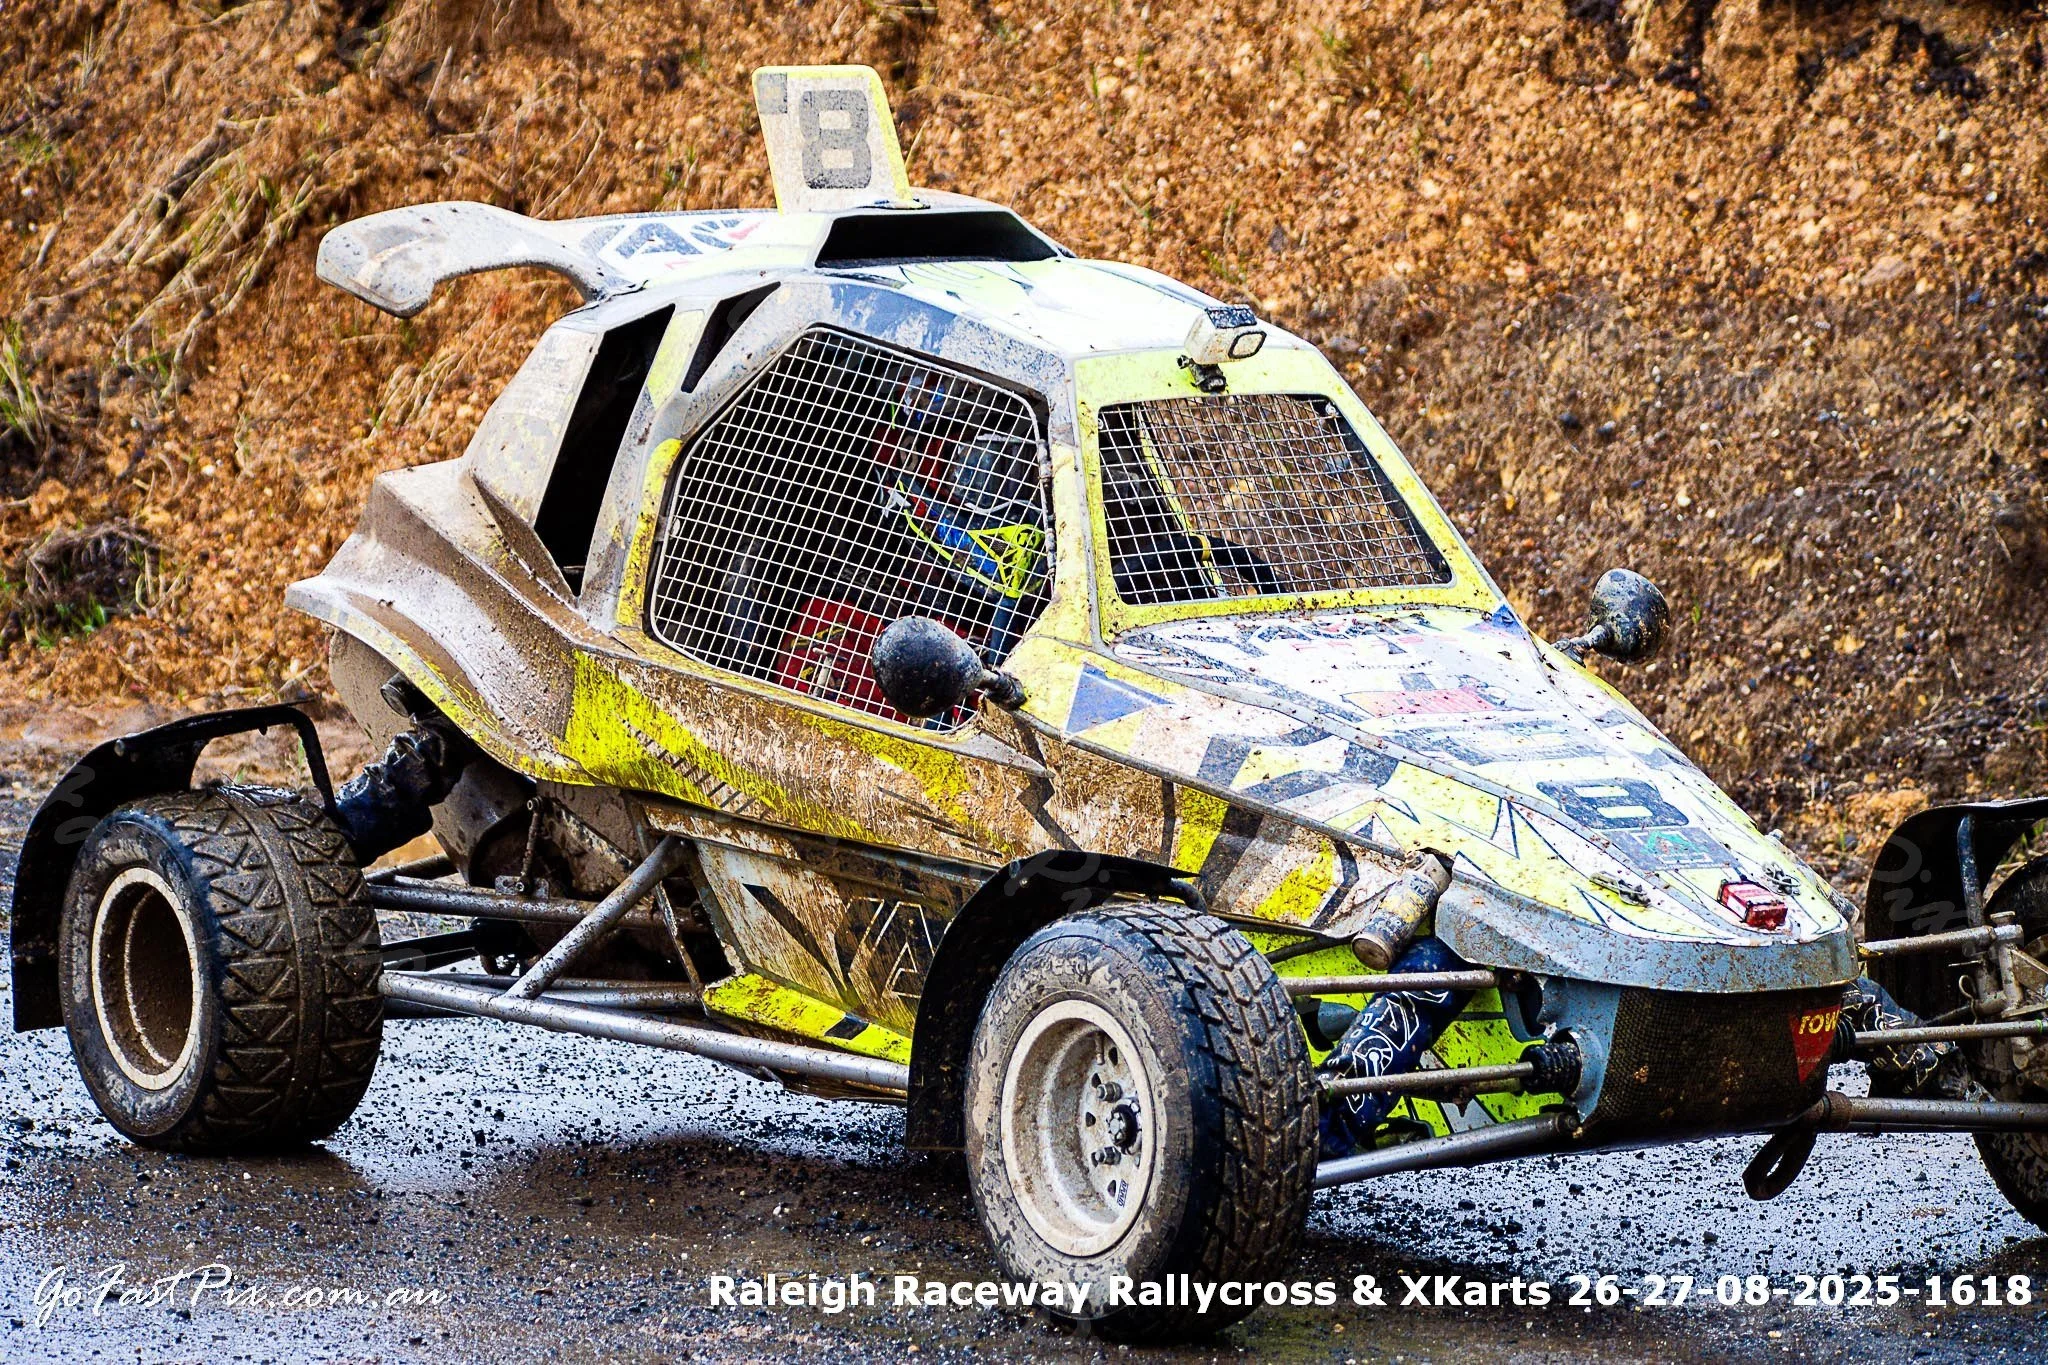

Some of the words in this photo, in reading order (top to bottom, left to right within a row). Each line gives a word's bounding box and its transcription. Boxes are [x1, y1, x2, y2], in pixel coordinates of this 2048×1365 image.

[800, 89, 872, 189] 8
[1536, 777, 1690, 830] 8
[1799, 1009, 1840, 1034] TOW
